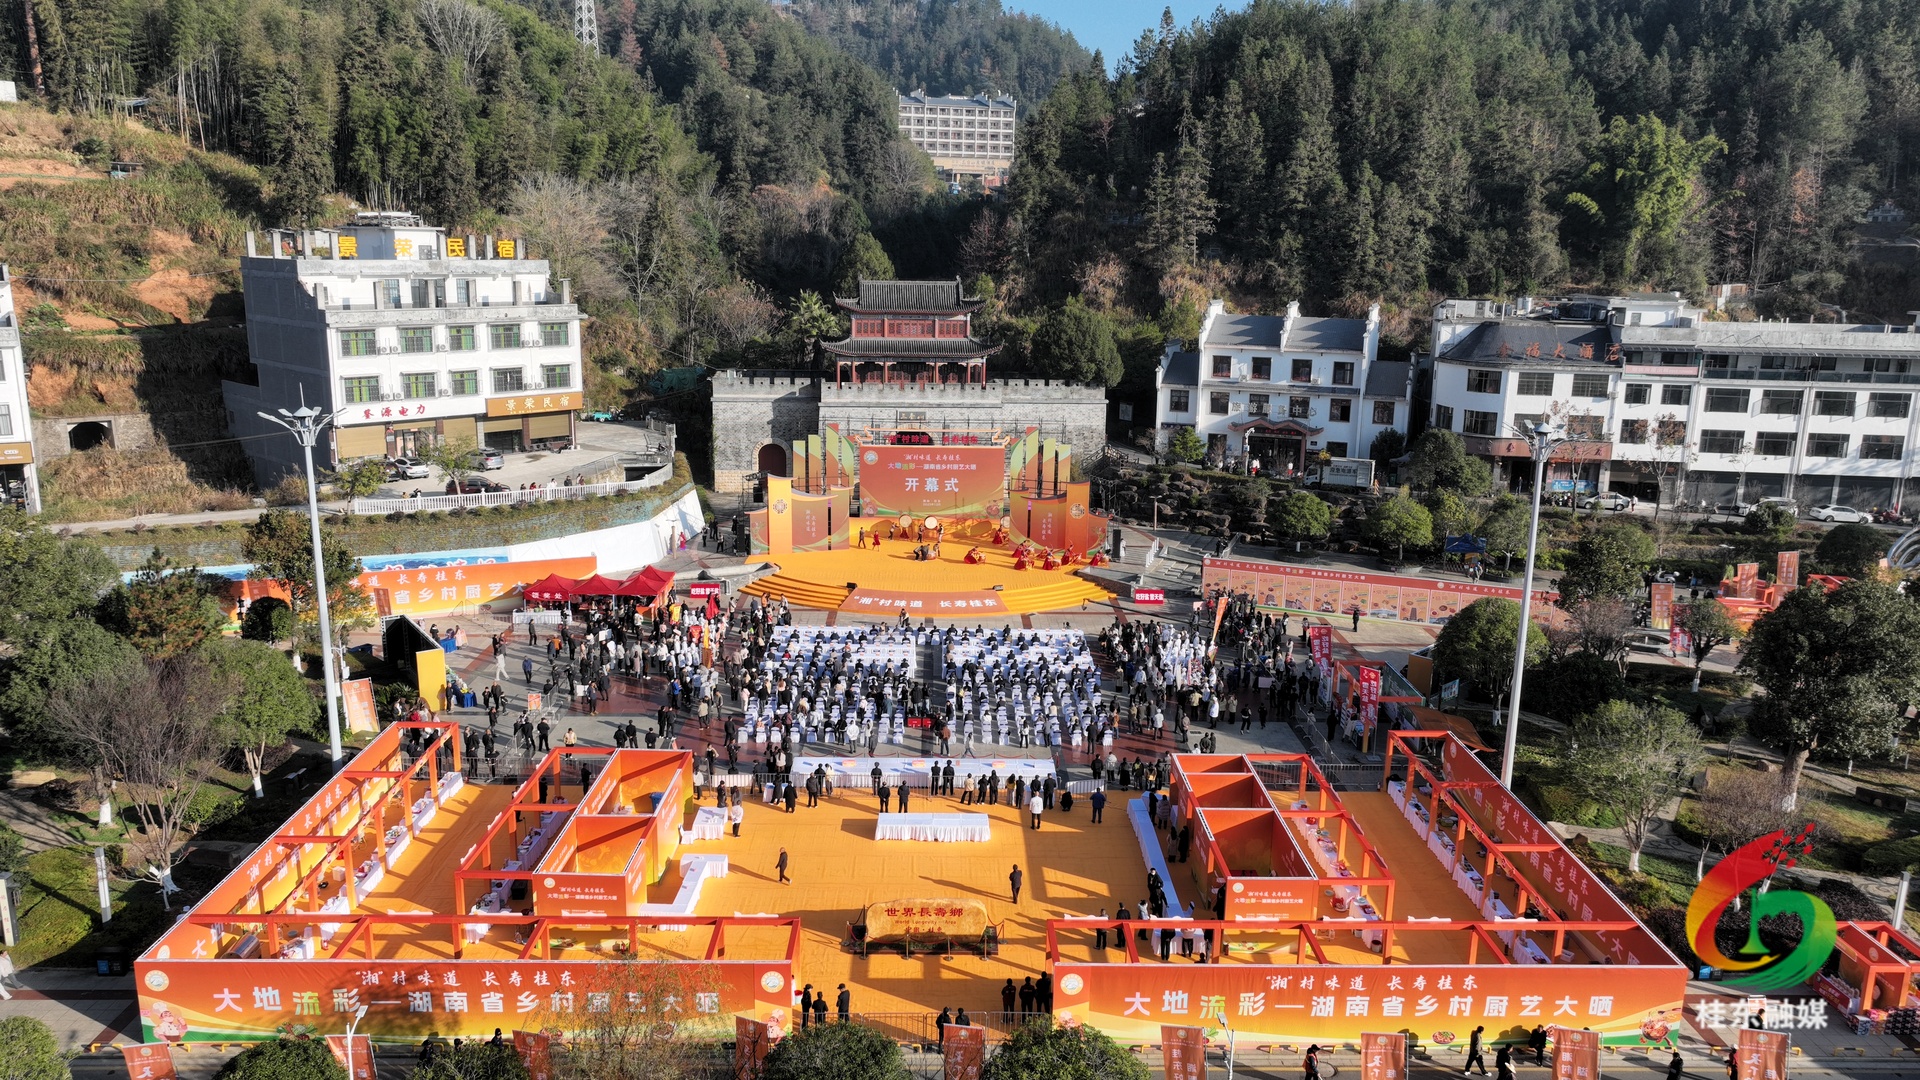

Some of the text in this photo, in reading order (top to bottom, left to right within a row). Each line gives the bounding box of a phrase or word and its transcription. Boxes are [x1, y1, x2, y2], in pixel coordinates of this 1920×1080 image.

[338, 235, 516, 259] 景荣民宿
[505, 394, 570, 411] 景荣民宿
[1231, 401, 1317, 417] 旅游服务中心
[904, 477, 960, 493] 开幕式
[396, 568, 467, 585] 长寿桂东
[939, 598, 998, 608] 长寿桂东
[354, 969, 577, 987] “湘”村味道 长寿桂东
[1265, 974, 1479, 991] “湘”村味道 长寿桂东
